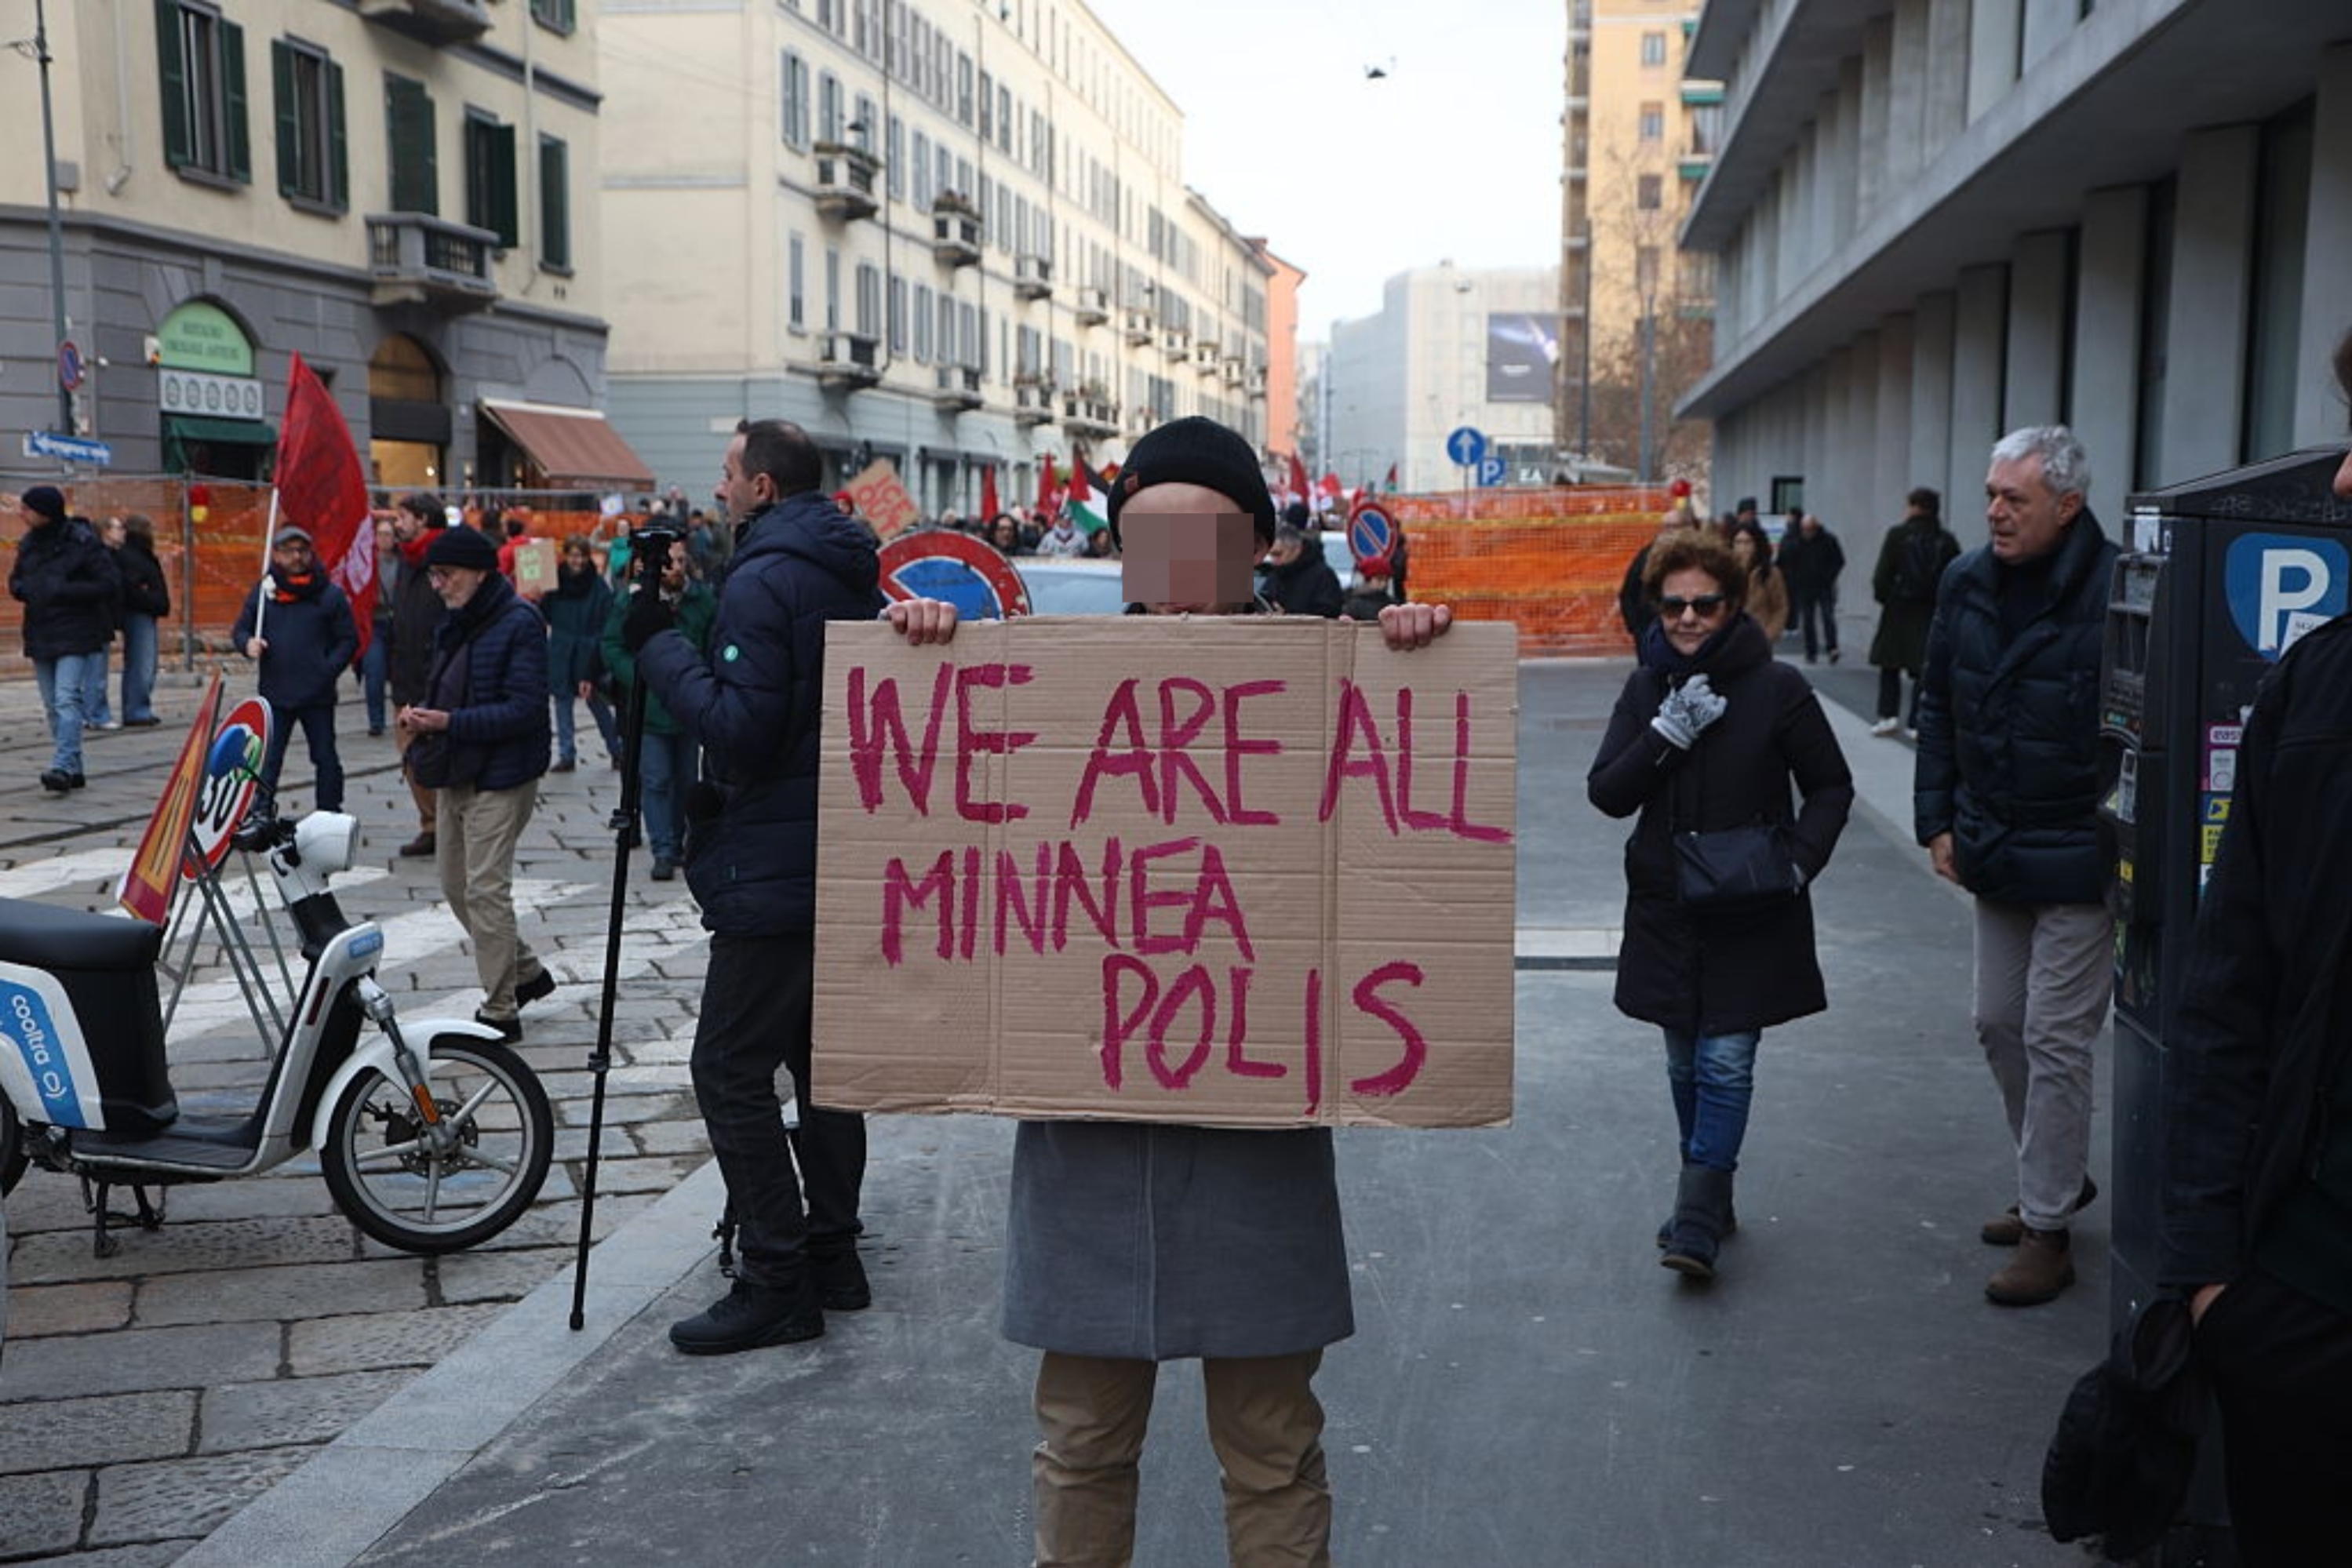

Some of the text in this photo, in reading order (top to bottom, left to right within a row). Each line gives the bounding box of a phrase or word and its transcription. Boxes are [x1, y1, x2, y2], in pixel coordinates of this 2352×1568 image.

[857, 482, 902, 533] OUT
[875, 474, 916, 515] ICE
[1481, 460, 1501, 484] P
[2258, 548, 2330, 651] P
[848, 663, 1512, 842] WE ARE ALL
[882, 837, 1254, 968] MINNEA
[12, 995, 51, 1065] cooltra
[1101, 952, 1426, 1115] POLIS
